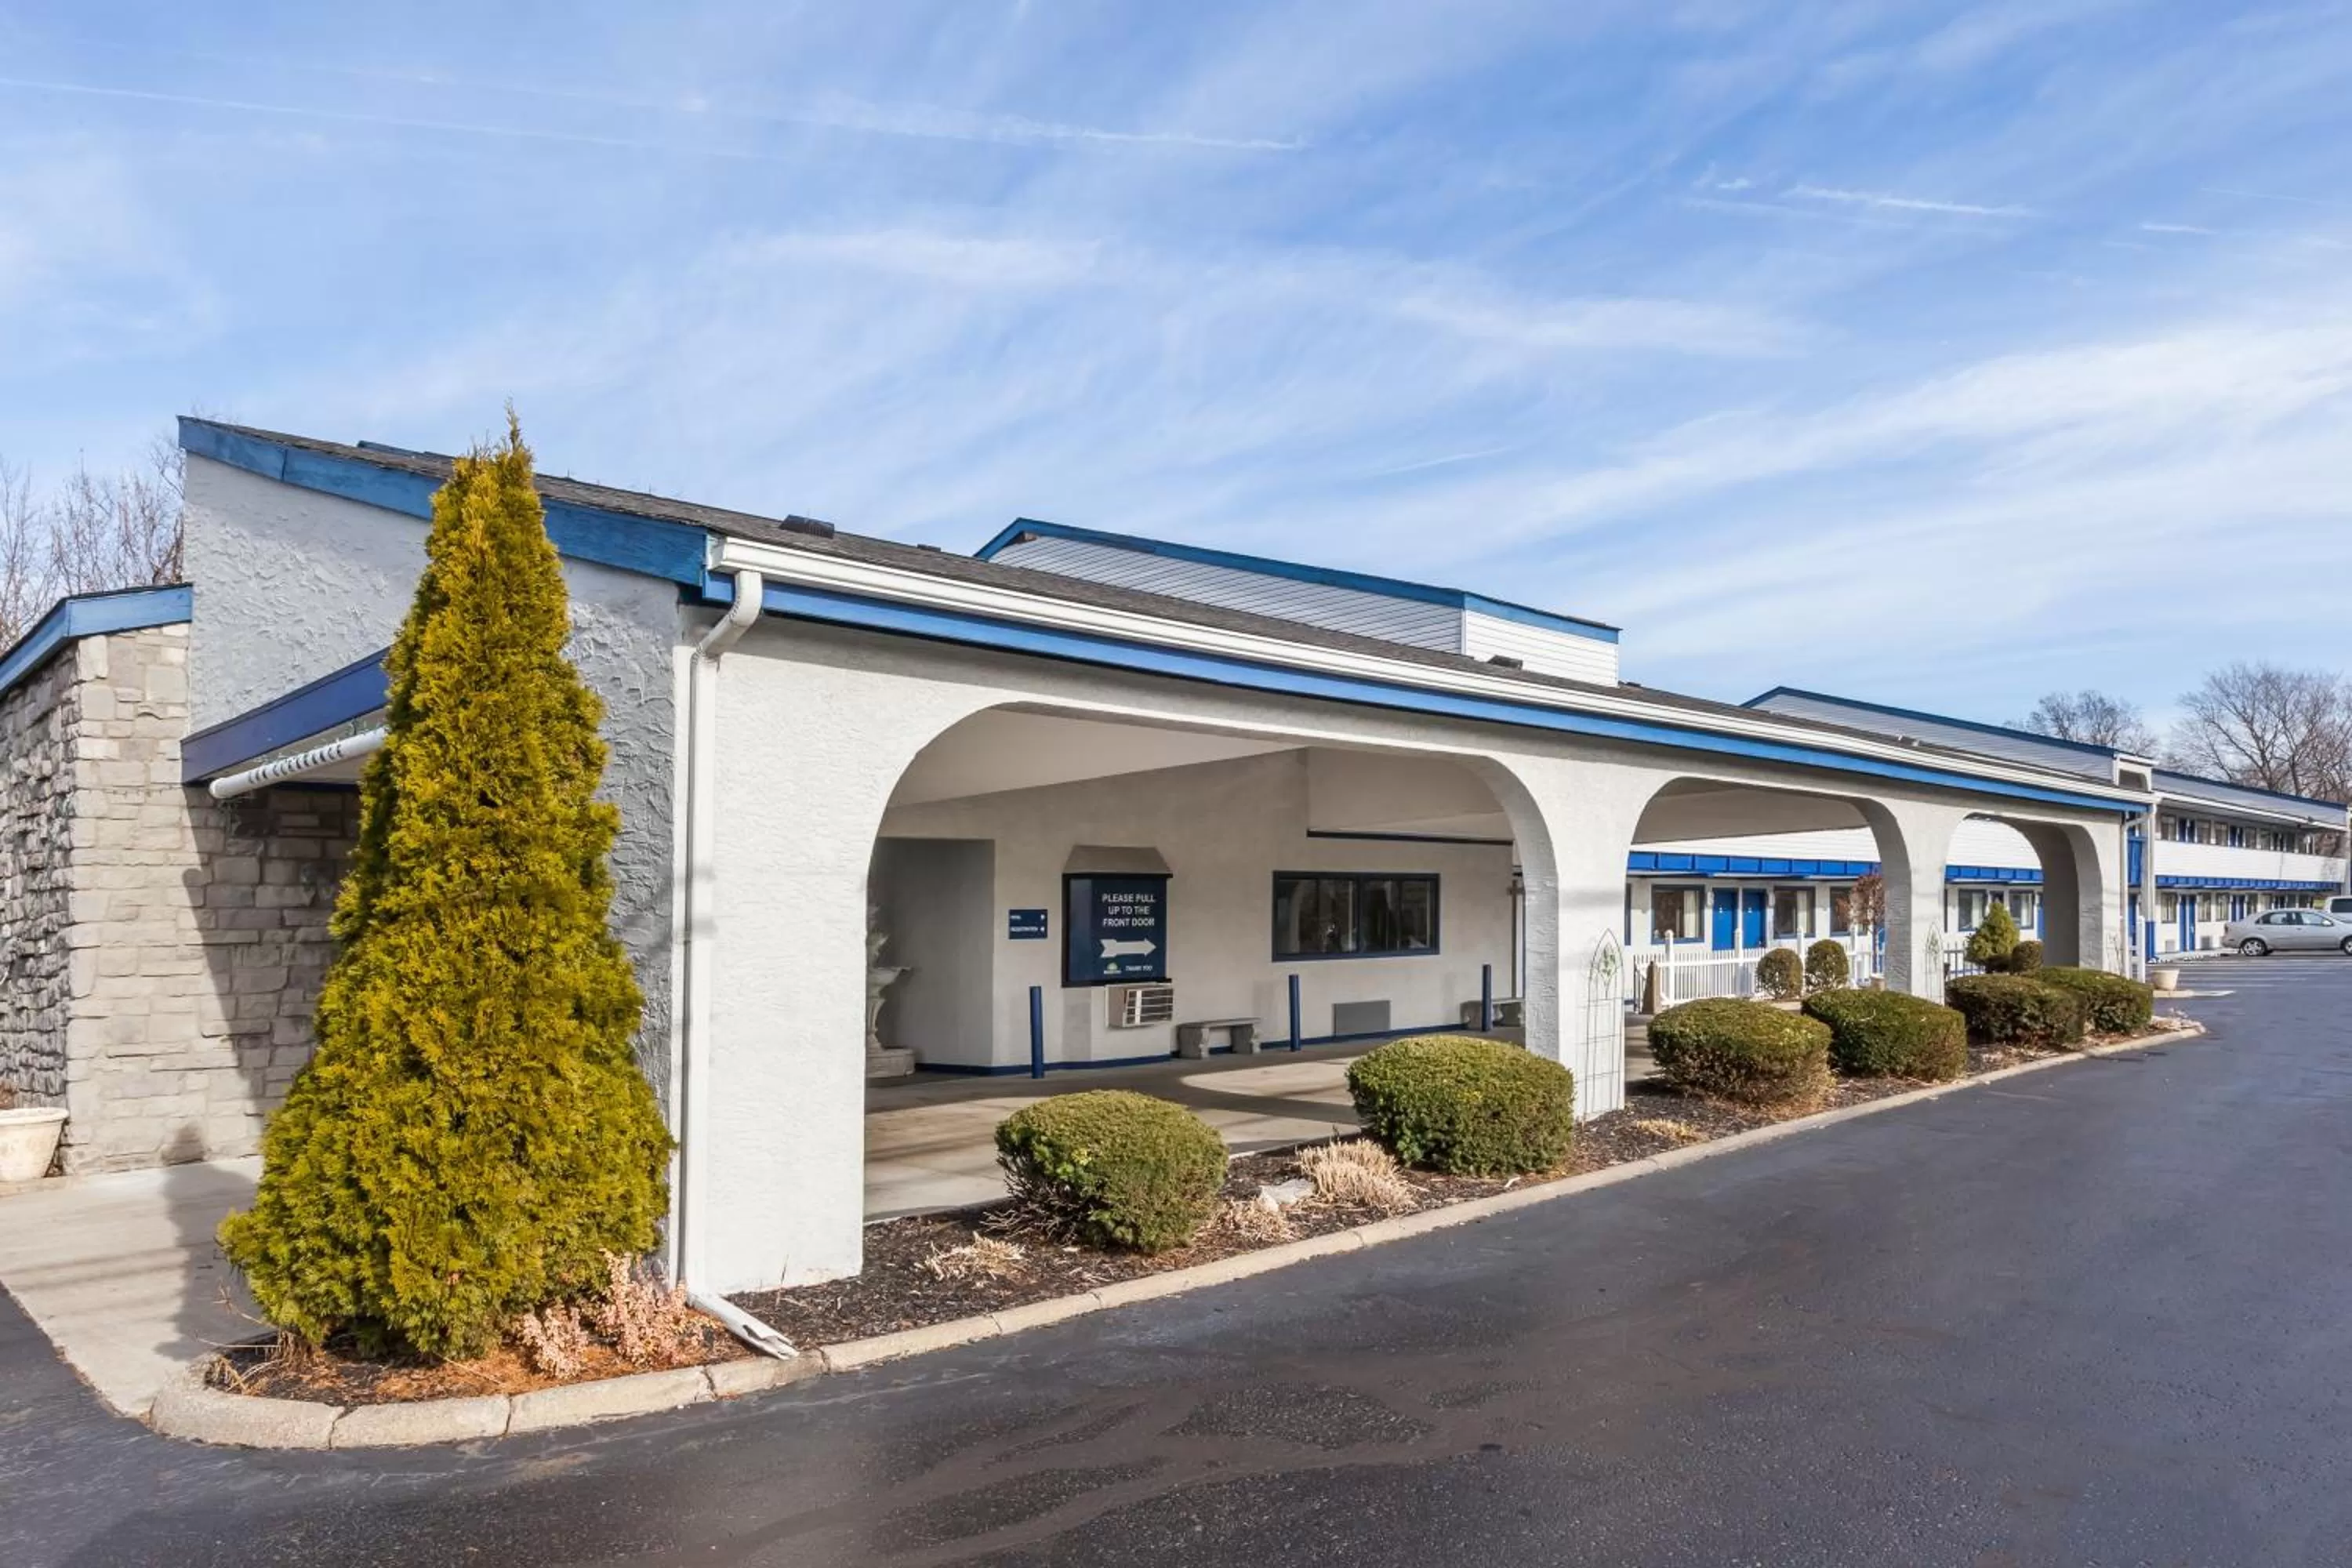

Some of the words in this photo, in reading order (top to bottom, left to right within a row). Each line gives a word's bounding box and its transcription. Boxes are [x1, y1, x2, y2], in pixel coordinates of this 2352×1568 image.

[1102, 893, 1134, 902] PLEASE
[1135, 894, 1156, 902] PULL
[1108, 906, 1120, 915] UP
[1121, 906, 1132, 915] TO
[1134, 906, 1150, 915] THE
[1103, 918, 1130, 927] FRONT
[1132, 918, 1155, 927] DOOR
